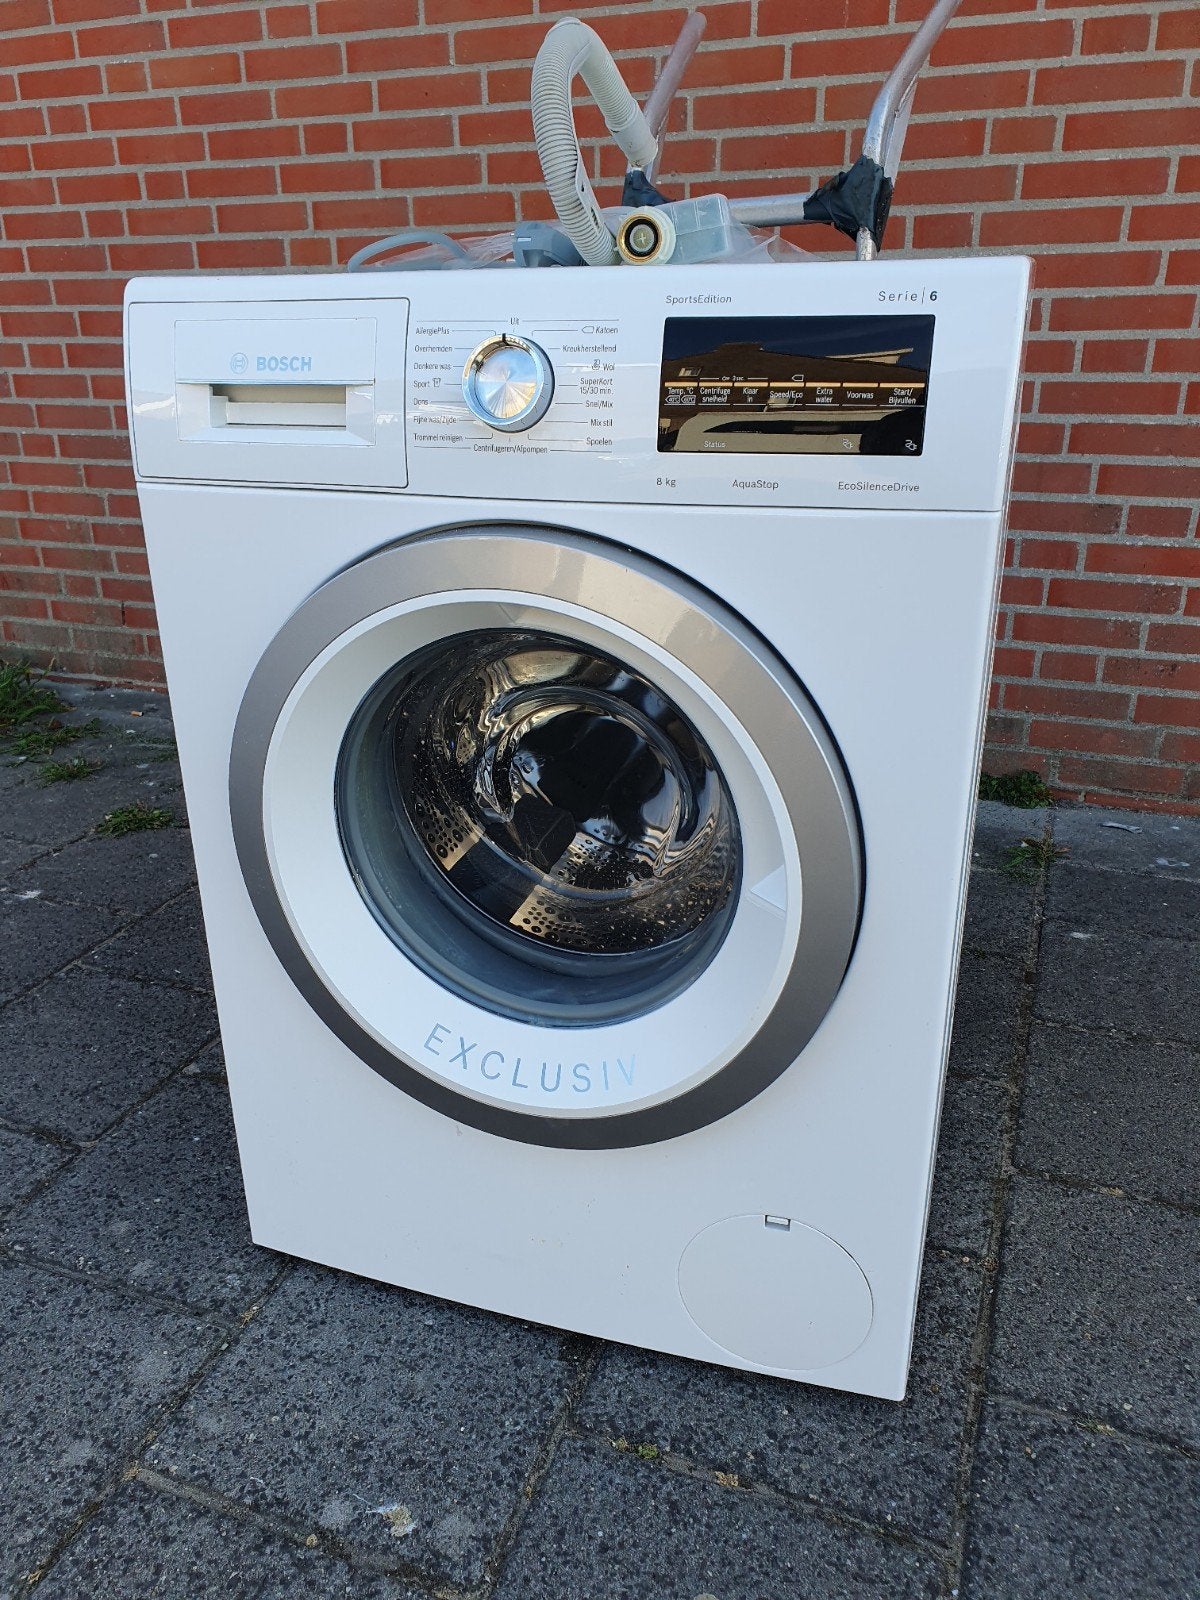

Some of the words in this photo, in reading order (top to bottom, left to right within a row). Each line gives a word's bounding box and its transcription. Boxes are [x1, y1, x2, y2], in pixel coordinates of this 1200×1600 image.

[665, 294, 732, 304] SportsEdition
[878, 290, 918, 302] Serie
[929, 290, 938, 302] 6
[415, 327, 449, 336] AllergiePlus
[595, 326, 619, 334] Katoen
[414, 344, 453, 353] Overhemden
[562, 344, 617, 353] Kreukherstellend
[256, 356, 312, 372] BOSCH
[413, 362, 439, 370] Donkere
[602, 363, 615, 371] Wol
[413, 380, 430, 389] Sport
[580, 377, 613, 387] SuperKort
[579, 386, 599, 395] 15/30
[668, 387, 686, 395] Temp.
[699, 387, 731, 395] Centrifuge
[742, 387, 759, 395] Klaar
[815, 387, 833, 395] Extra
[846, 390, 874, 399] Voorwas
[413, 398, 429, 406] Dons
[584, 400, 613, 409] Snel/Mix
[815, 396, 833, 404] water
[888, 396, 917, 406] Bijvullen
[590, 419, 602, 427] Mix
[602, 419, 613, 427] stil
[413, 433, 439, 441] Trommel
[440, 433, 463, 443] reinigen
[586, 437, 613, 446] Spoelen
[473, 443, 548, 454] Centrifugeren/Afpompen
[704, 440, 726, 449] Status
[656, 477, 663, 486] 8
[665, 477, 676, 488] kg
[732, 479, 779, 490] AquaStop
[838, 481, 920, 492] EcoSilenceDrive
[423, 1022, 636, 1093] EXCLUSIV
